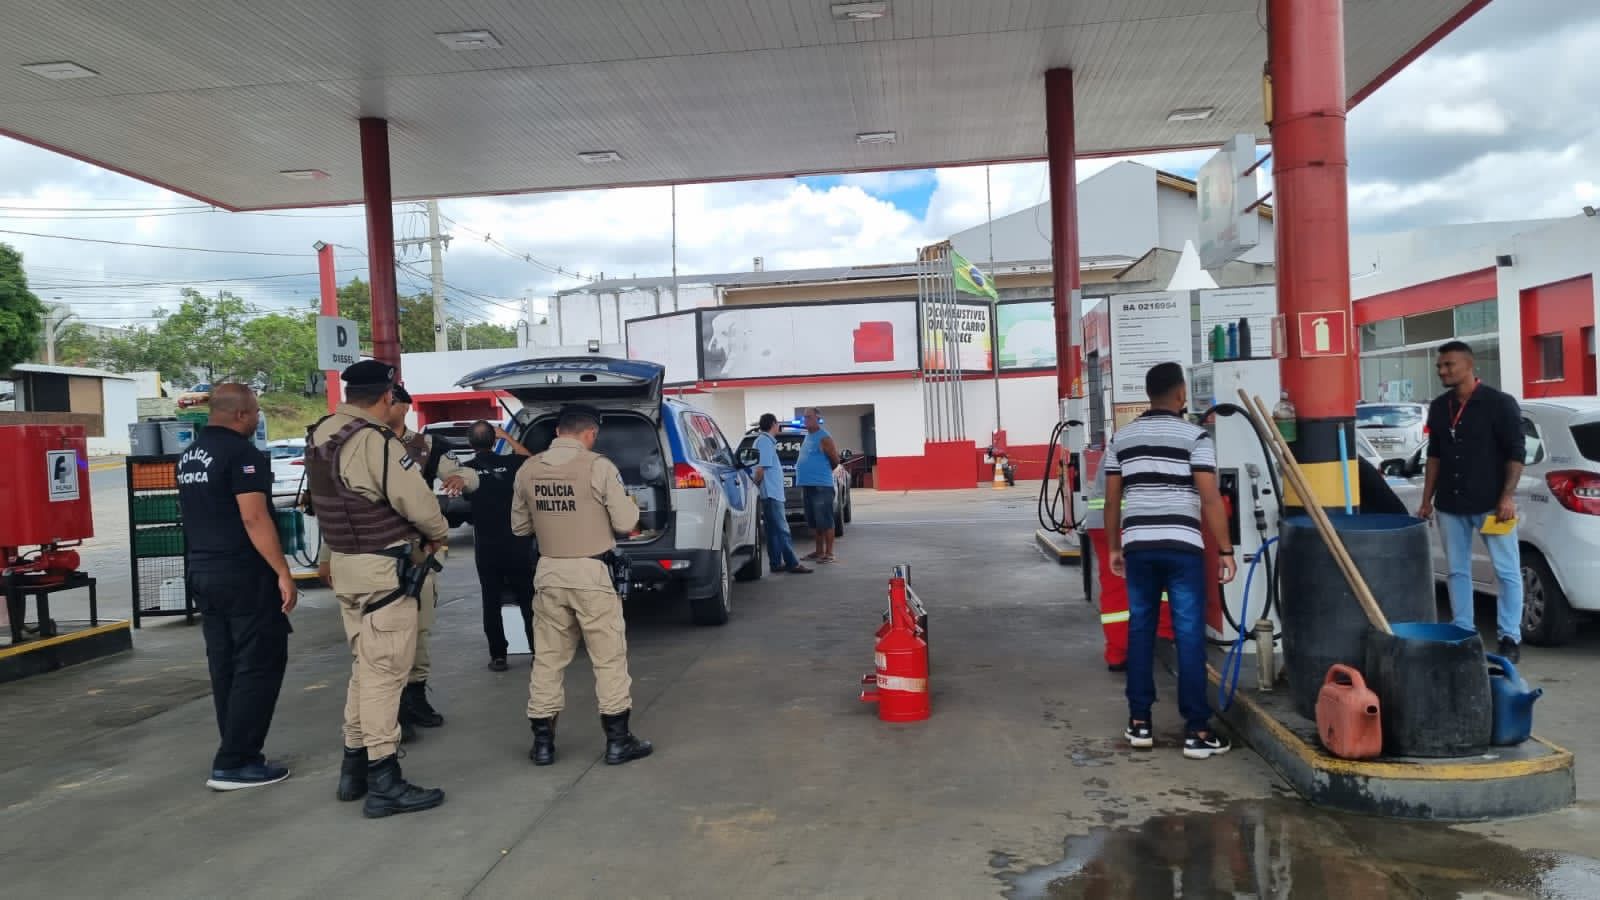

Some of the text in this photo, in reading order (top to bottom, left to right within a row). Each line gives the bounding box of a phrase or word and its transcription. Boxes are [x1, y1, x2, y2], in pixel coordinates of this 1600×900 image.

[1122, 303, 1135, 311] BA
[961, 321, 986, 333] CARRO
[336, 325, 347, 347] D
[944, 331, 972, 343] MECE
[333, 354, 354, 364] DIESEL
[534, 482, 575, 497] POLÍCIA
[536, 499, 577, 512] MILITAR
